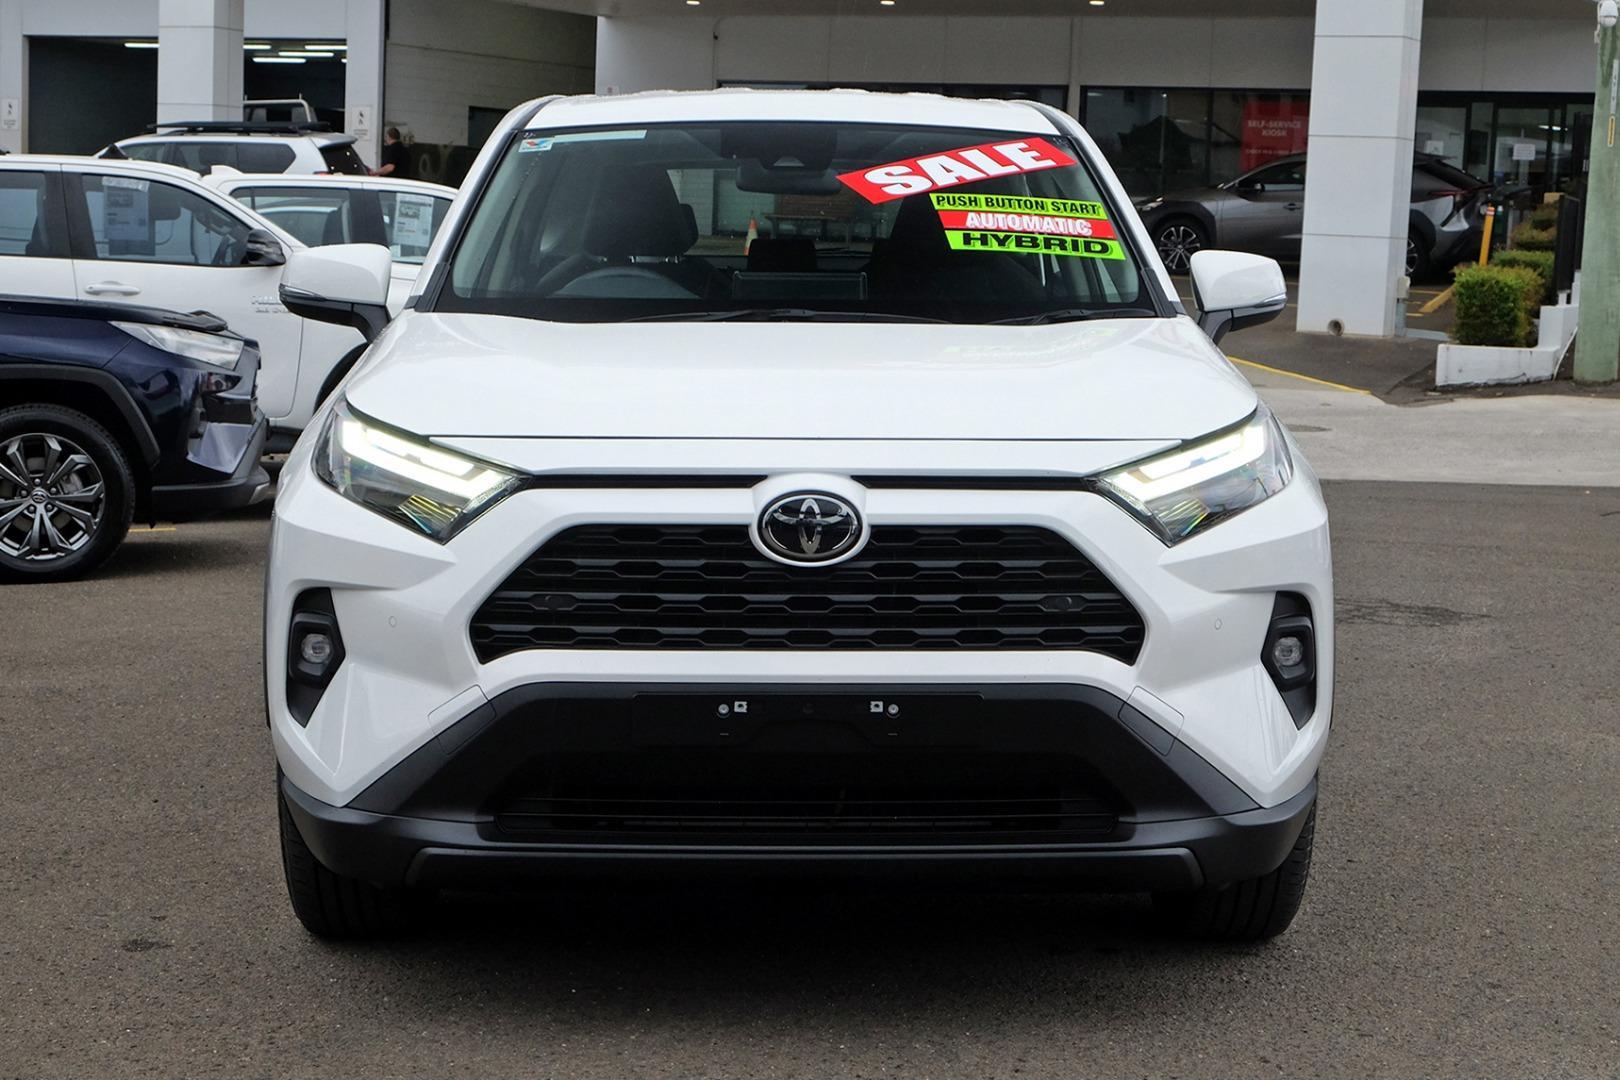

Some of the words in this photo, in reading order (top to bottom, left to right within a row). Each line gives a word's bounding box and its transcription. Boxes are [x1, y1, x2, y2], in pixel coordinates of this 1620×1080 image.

[1262, 128, 1288, 136] KIOSK
[864, 142, 1056, 195] SALE
[936, 195, 979, 208] PUSH
[985, 196, 1047, 212] BUTTON
[1051, 200, 1100, 215] START
[965, 212, 1093, 236] AUTOMATIC
[962, 232, 1112, 255] HYBRID
